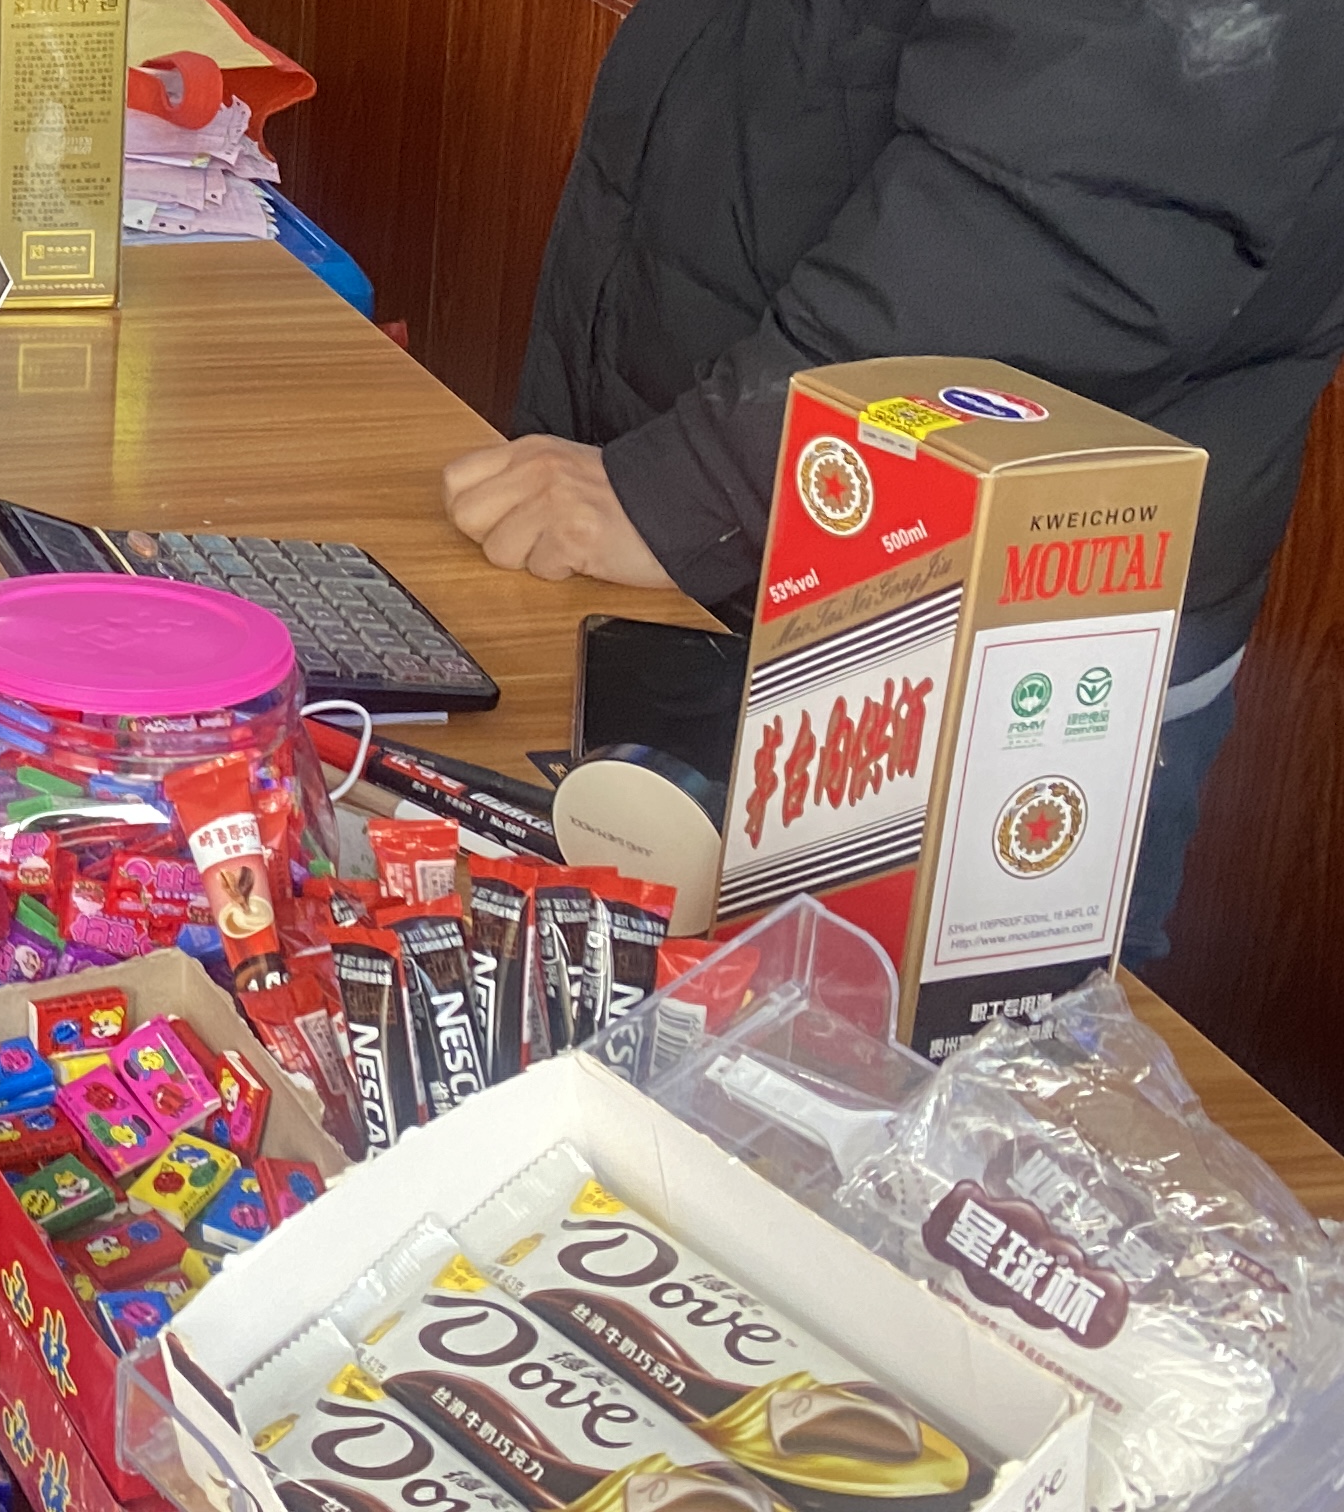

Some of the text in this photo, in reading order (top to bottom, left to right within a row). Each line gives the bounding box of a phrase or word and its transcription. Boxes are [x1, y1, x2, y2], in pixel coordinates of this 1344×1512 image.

[882, 519, 929, 554] 500ml
[1029, 504, 1159, 532] KWEICHOW
[769, 567, 821, 605] 53%vol
[998, 531, 1172, 606] MOUTAI
[742, 676, 934, 850] 茅台内供酒
[557, 1219, 783, 1366] Dove
[944, 1197, 1106, 1336] 星球杯
[418, 1294, 638, 1450] Dove
[569, 1301, 688, 1398] 丝滑牛奶巧克力
[430, 1386, 545, 1485] 丝滑牛奶巧克力
